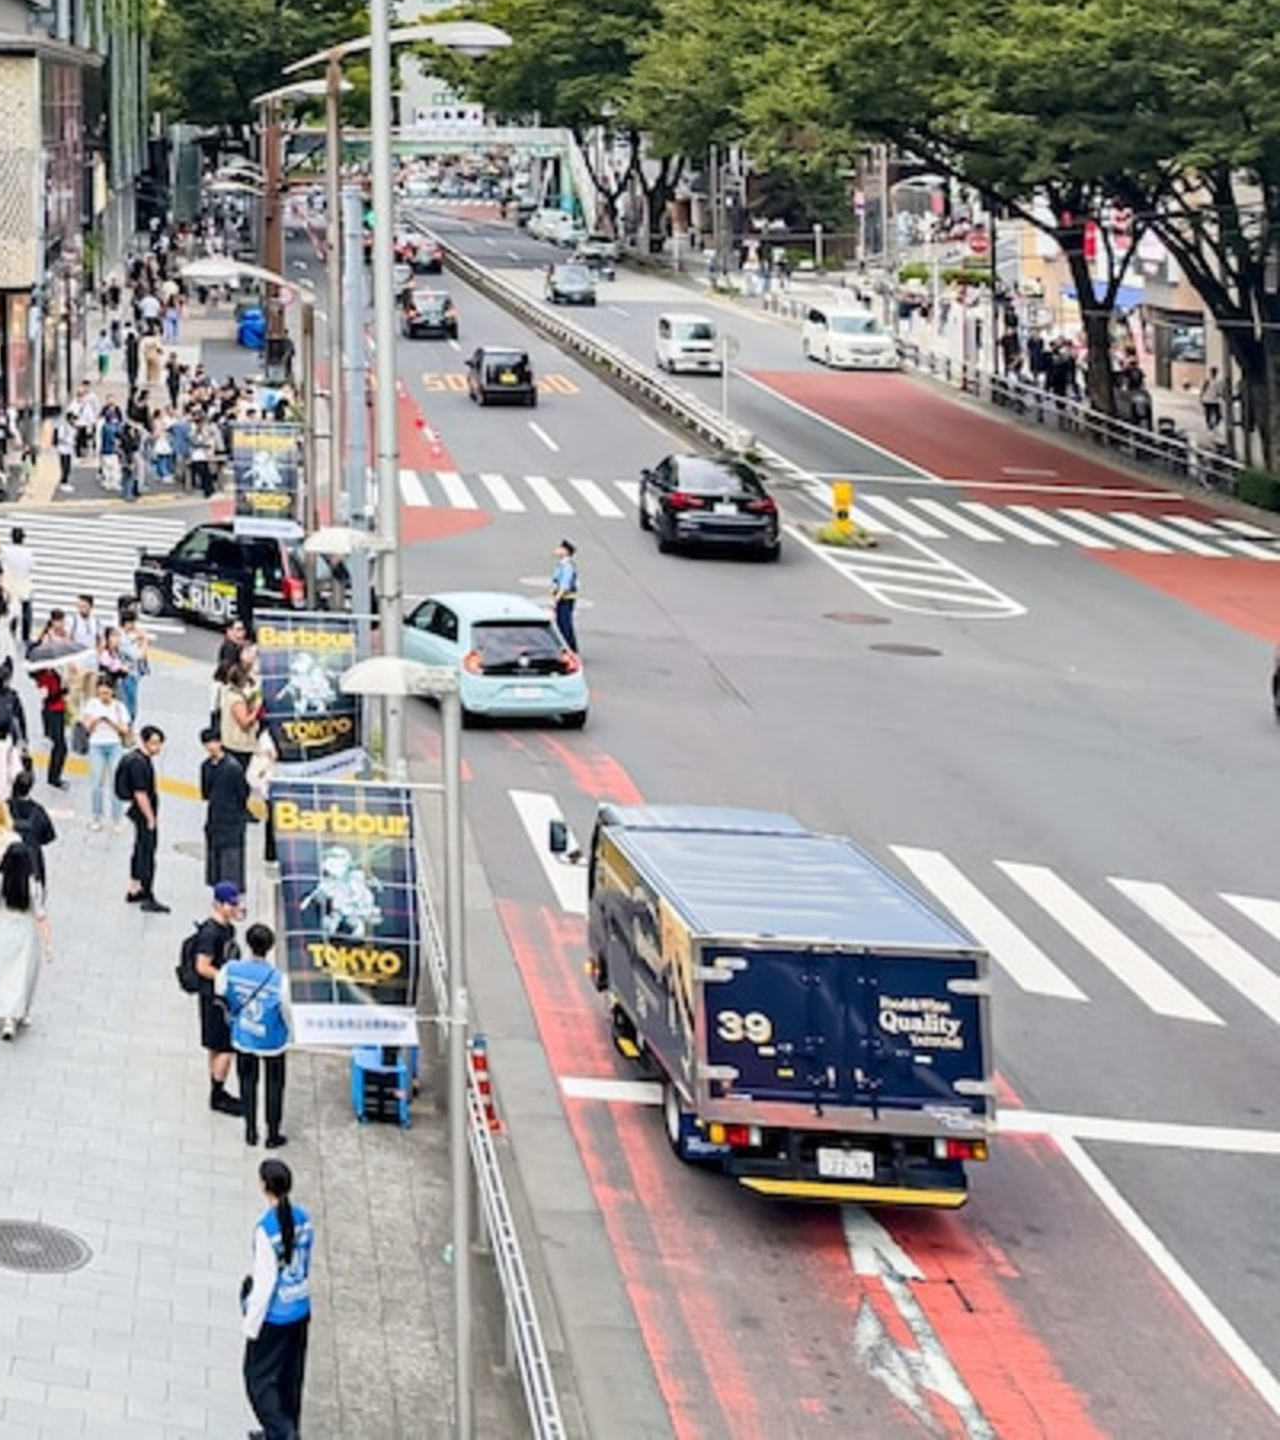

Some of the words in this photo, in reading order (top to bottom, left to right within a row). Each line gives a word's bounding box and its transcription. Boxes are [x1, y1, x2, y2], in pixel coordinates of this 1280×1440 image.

[274, 800, 410, 837] Barbour
[306, 942, 402, 976] TOKYO
[717, 1011, 772, 1043] 39
[878, 1010, 962, 1037] Quality
